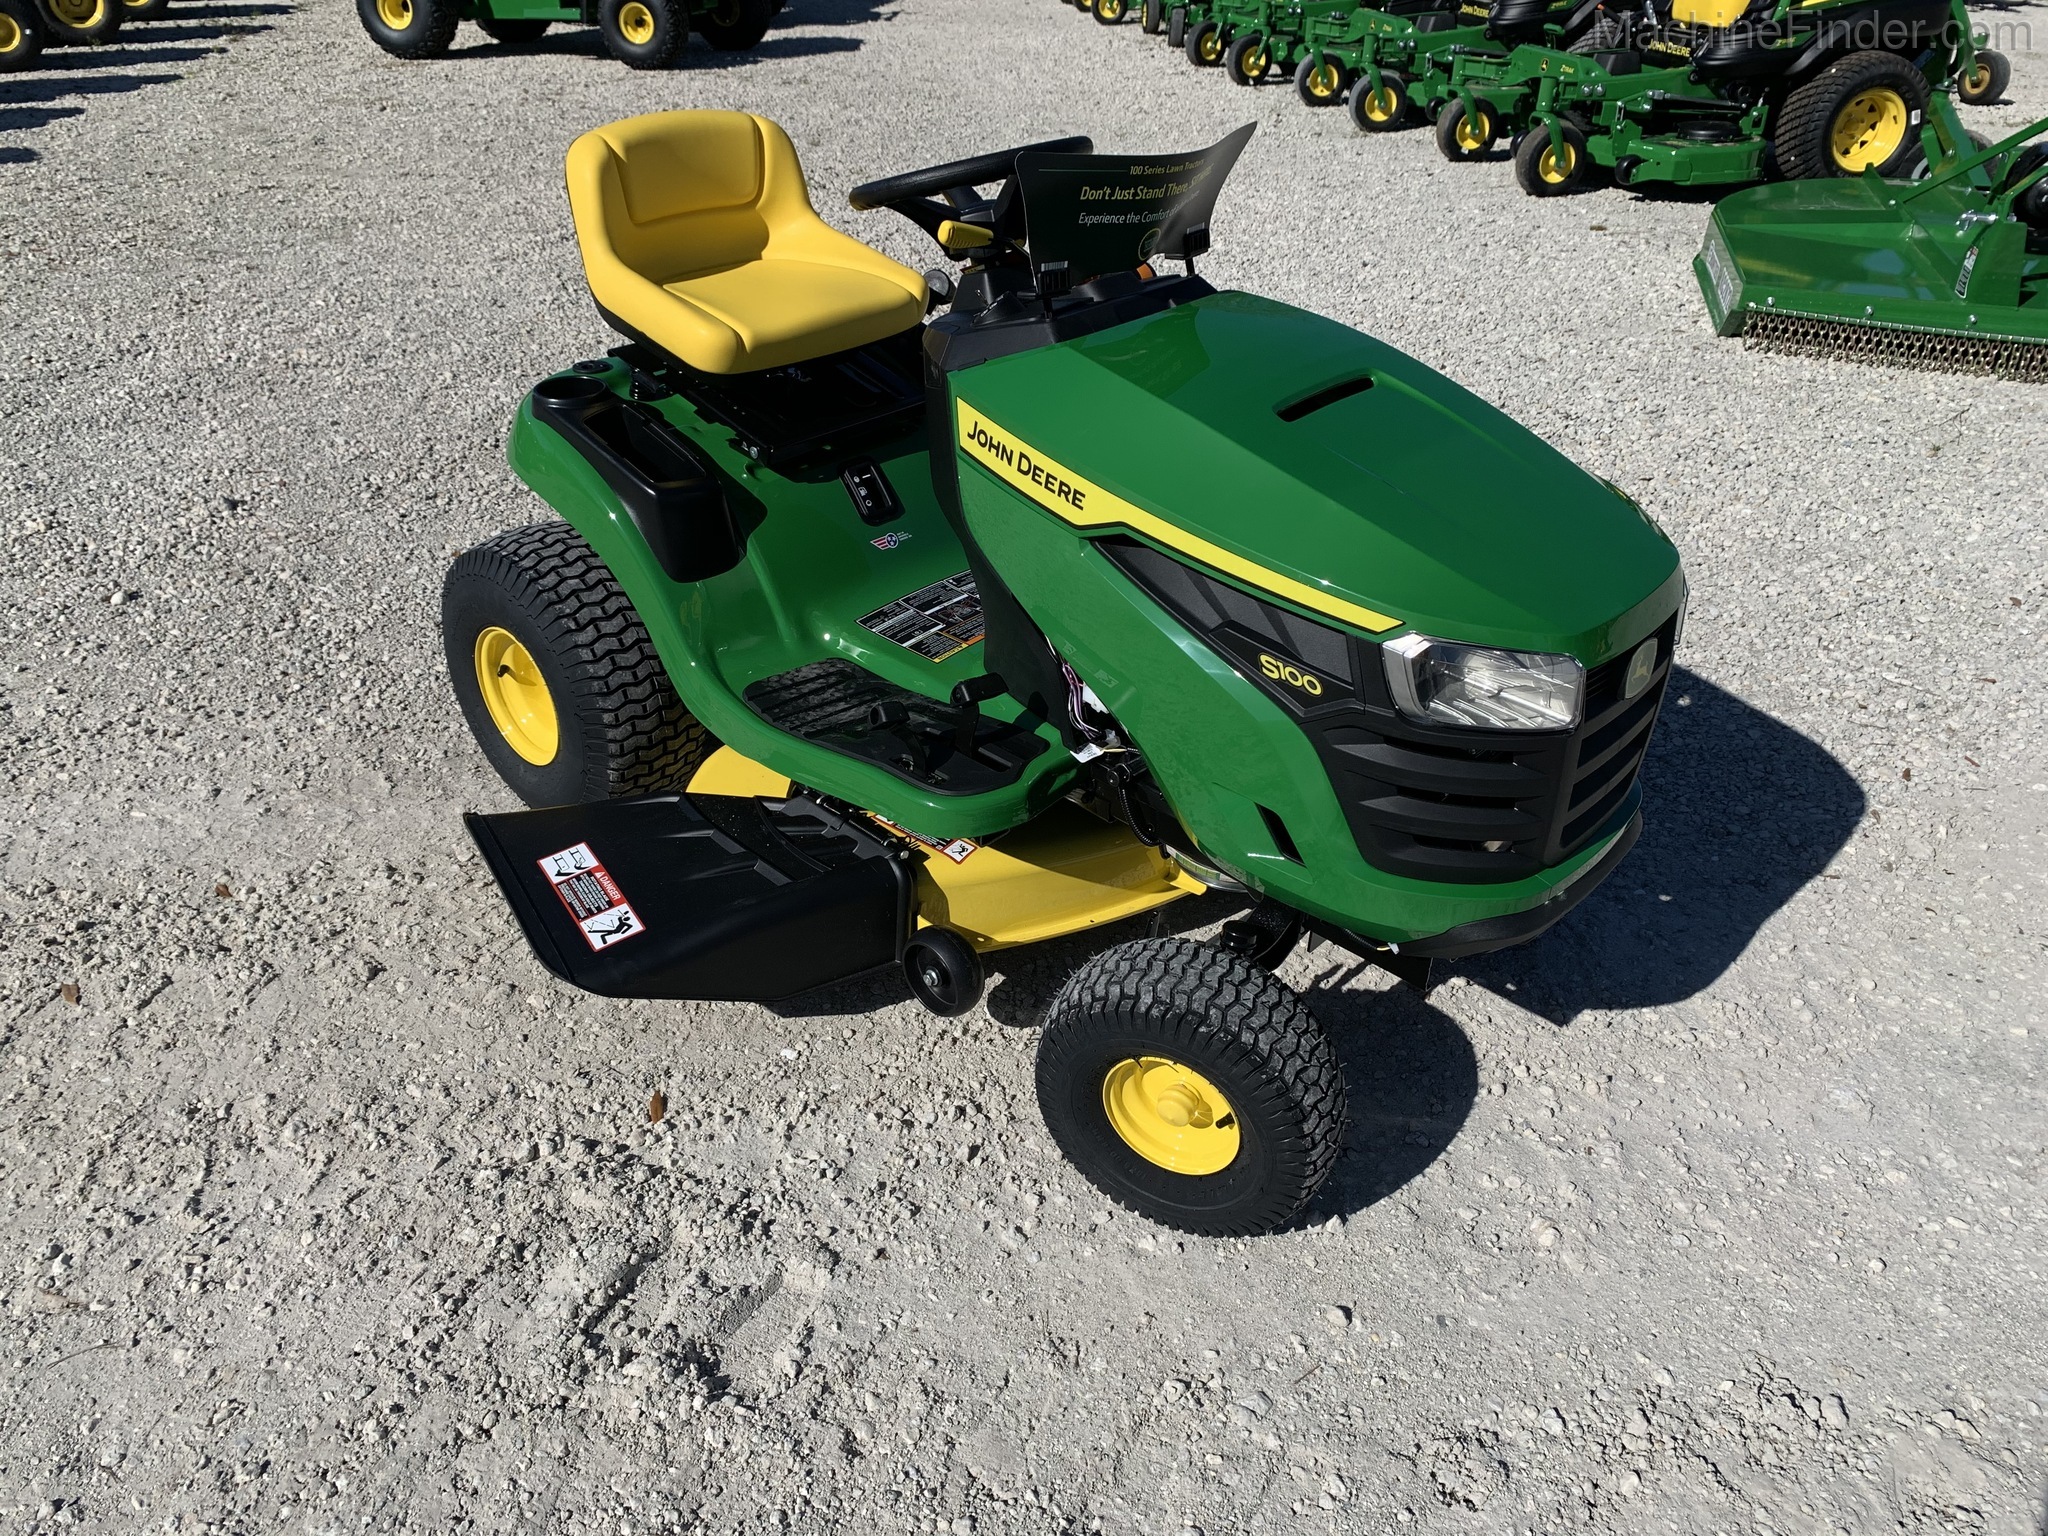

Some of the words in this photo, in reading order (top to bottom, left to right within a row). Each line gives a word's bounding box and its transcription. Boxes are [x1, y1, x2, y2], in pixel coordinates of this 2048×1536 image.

[1648, 38, 1666, 53] JOHN
[1667, 41, 1691, 57] DEERE
[1130, 165, 1143, 176] 100
[1143, 165, 1165, 175] Series
[1166, 164, 1183, 174] Lawn
[1080, 186, 1111, 200] Don't
[1111, 186, 1135, 200] Just
[1135, 183, 1166, 200] Stand
[1078, 212, 1125, 226] Experience
[1126, 211, 1140, 224] the
[1141, 208, 1170, 223] Comfort
[967, 420, 1014, 467] JOHN
[1016, 450, 1087, 512] DEERE
[1260, 654, 1322, 695] S100
[599, 875, 621, 901] DANGER
